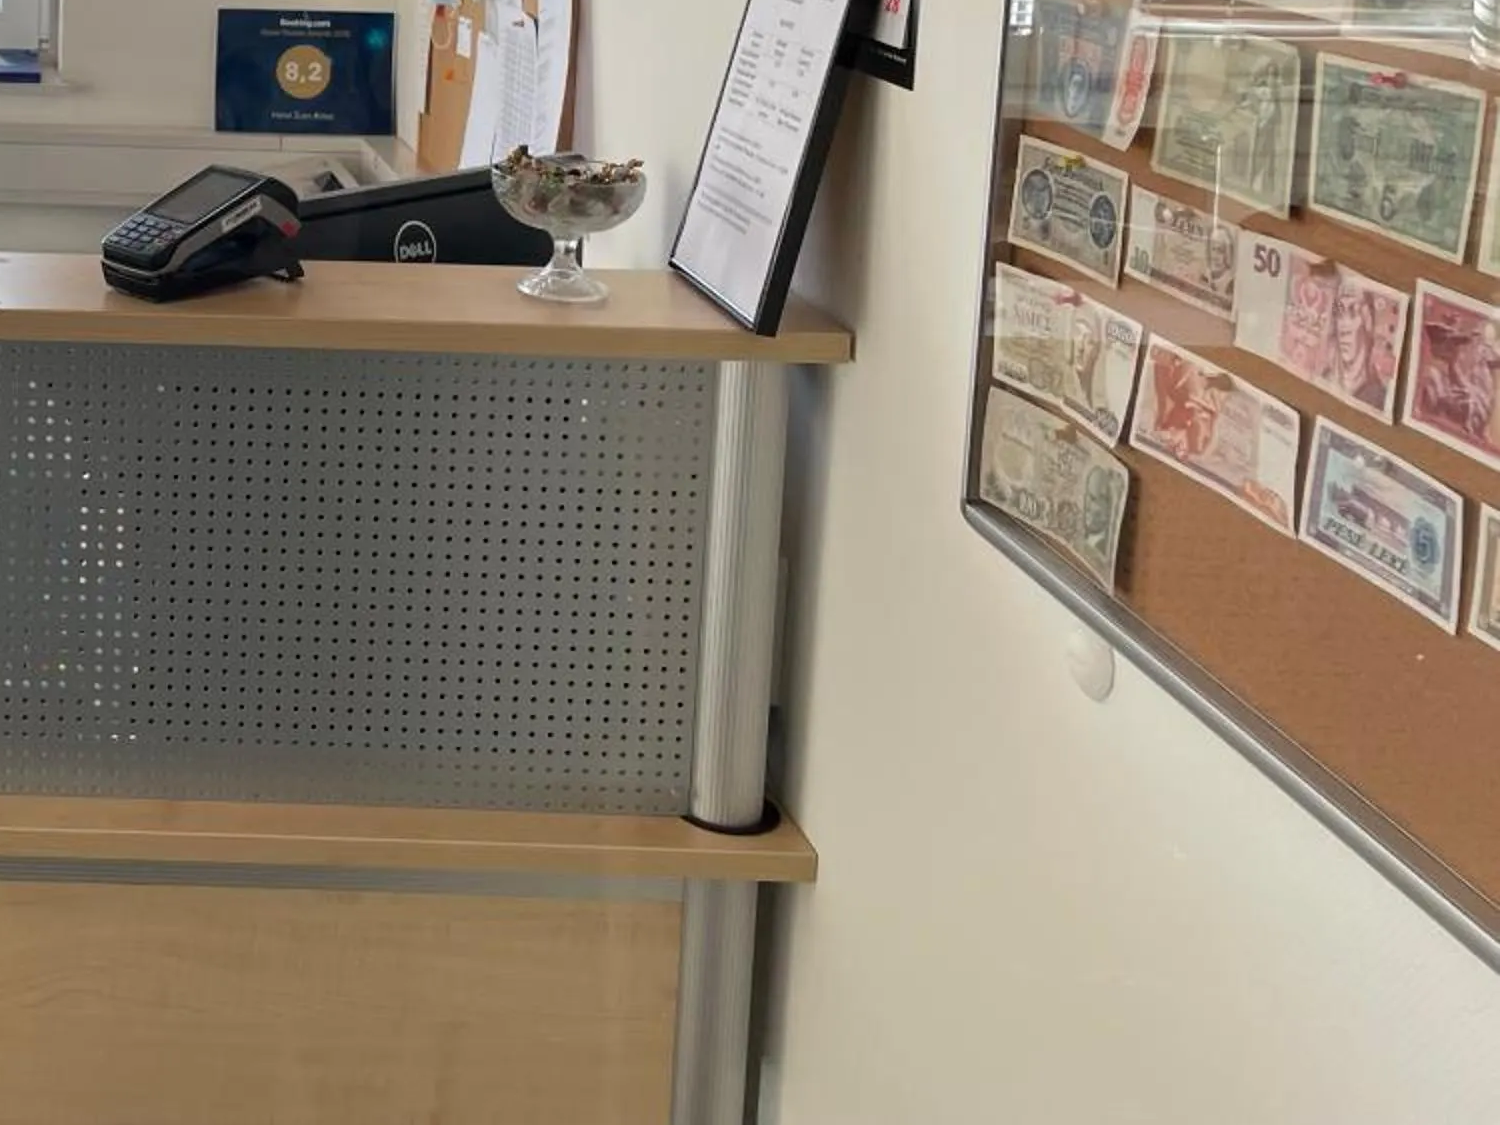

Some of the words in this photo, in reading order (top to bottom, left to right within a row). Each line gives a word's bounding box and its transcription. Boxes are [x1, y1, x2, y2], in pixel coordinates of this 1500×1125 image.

[285, 60, 323, 84] 8,2
[399, 239, 432, 259] DELL
[1253, 242, 1281, 278] 50
